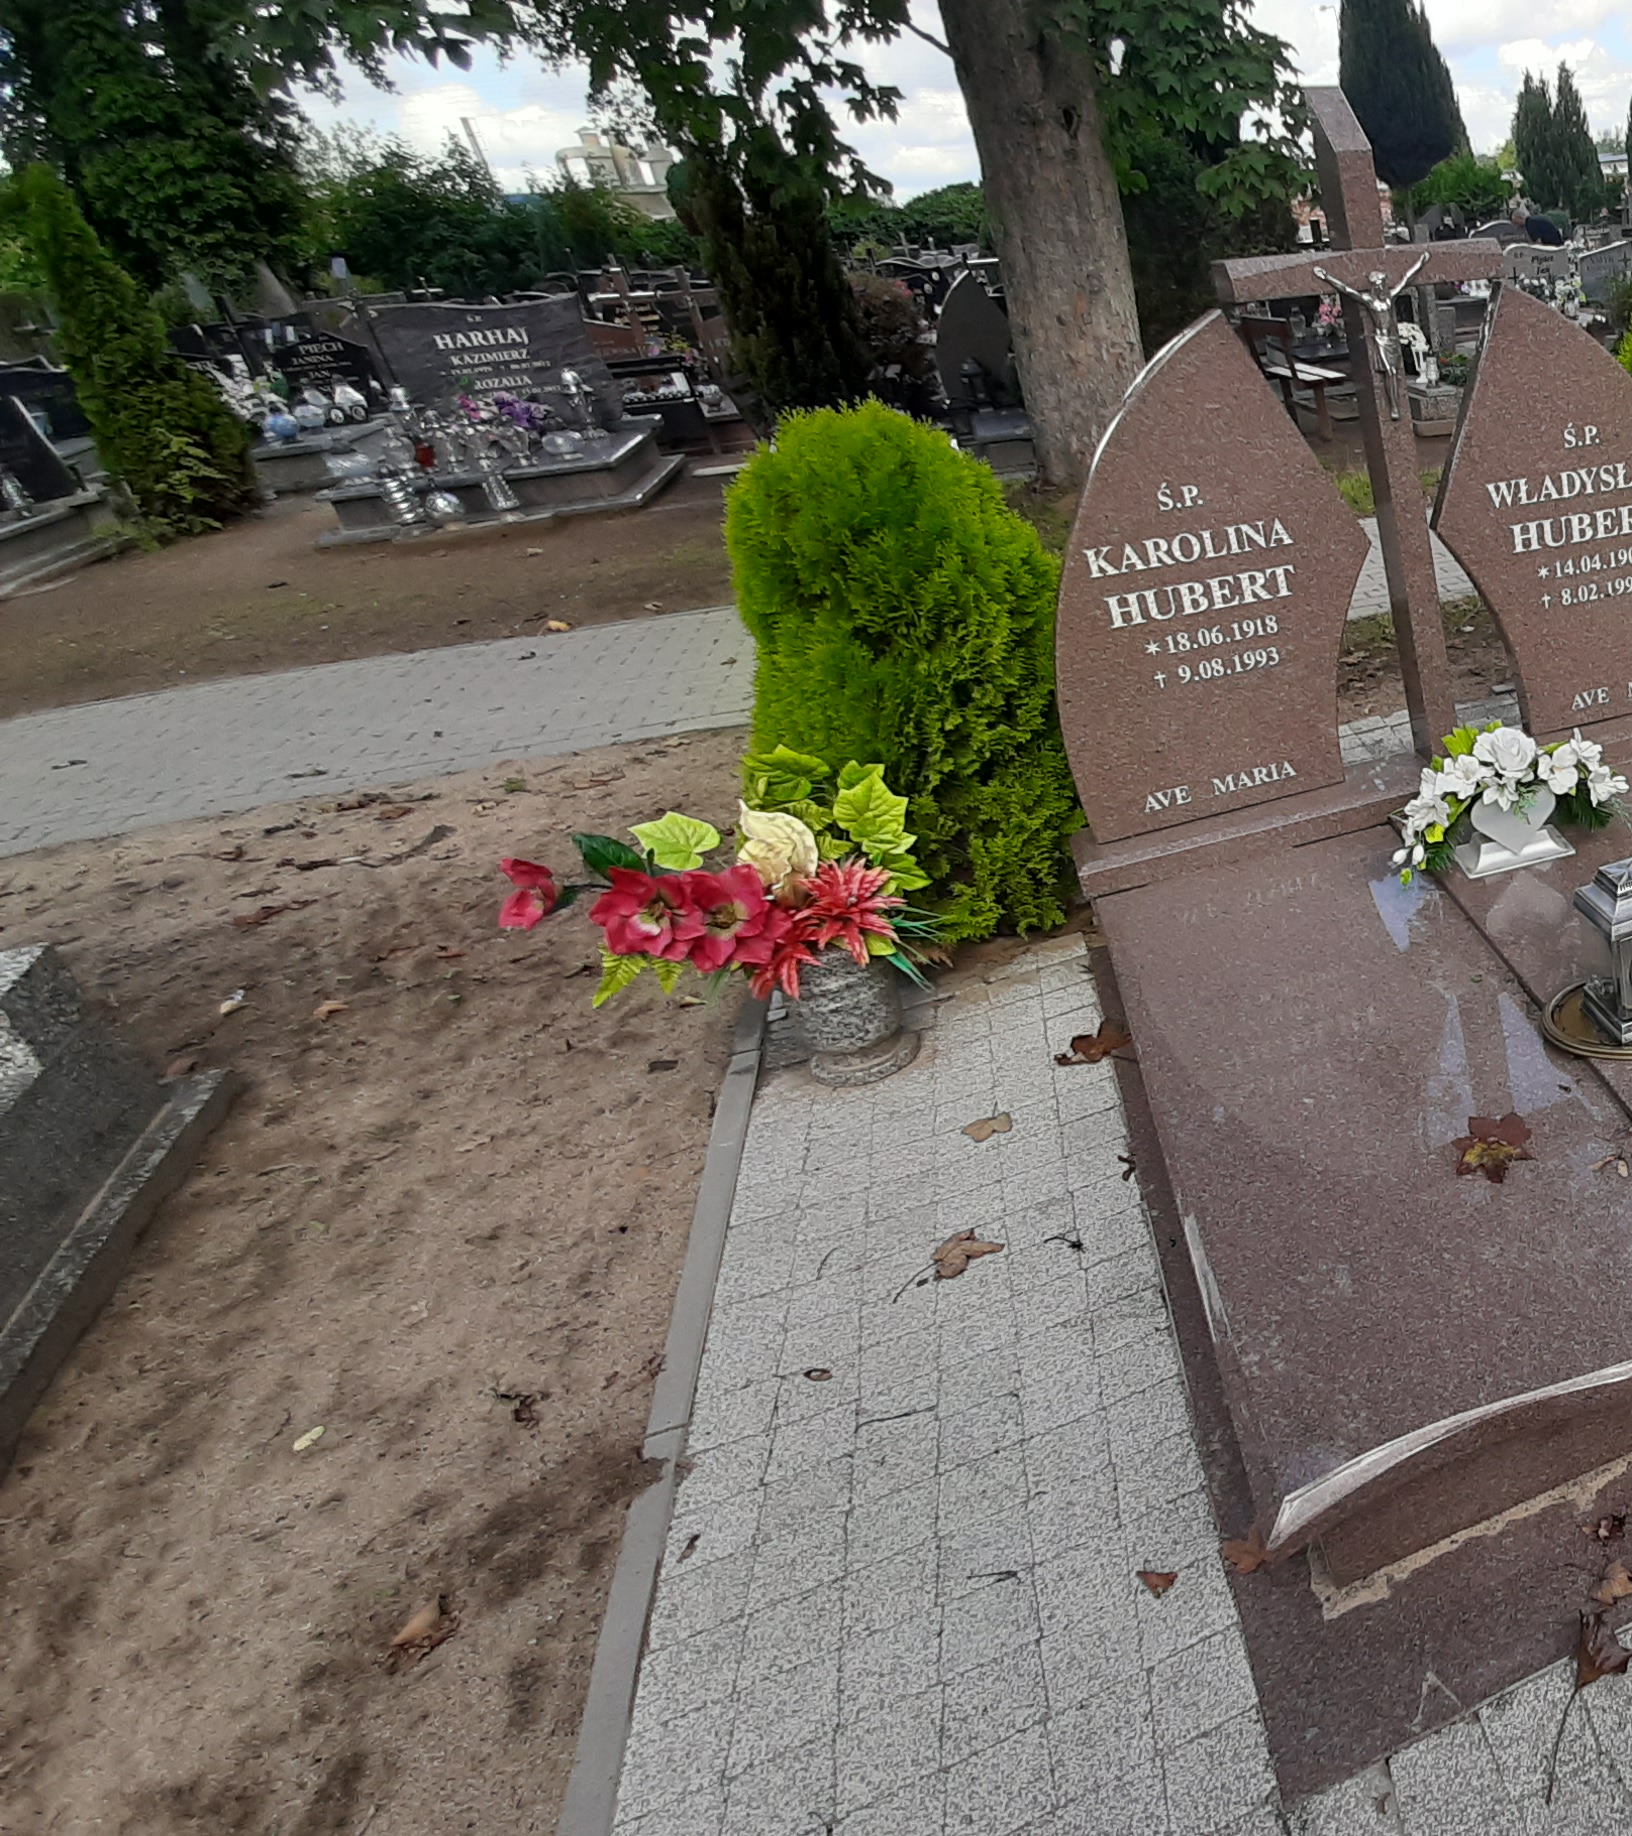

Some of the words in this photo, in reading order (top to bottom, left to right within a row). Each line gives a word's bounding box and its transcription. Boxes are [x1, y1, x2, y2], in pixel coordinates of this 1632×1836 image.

[433, 326, 530, 350] HARHAJ
[450, 348, 530, 366] KAZIMIERZ
[1562, 422, 1601, 449] Ś.P.
[1157, 482, 1204, 512] Ś.P.
[1083, 517, 1294, 578] KAROLINA
[1103, 564, 1296, 629] HUBERT
[1178, 646, 1280, 685] 9.08.1993
[1571, 687, 1610, 711] AVE
[1144, 785, 1192, 813] AVE
[1211, 760, 1297, 796] MARIA
